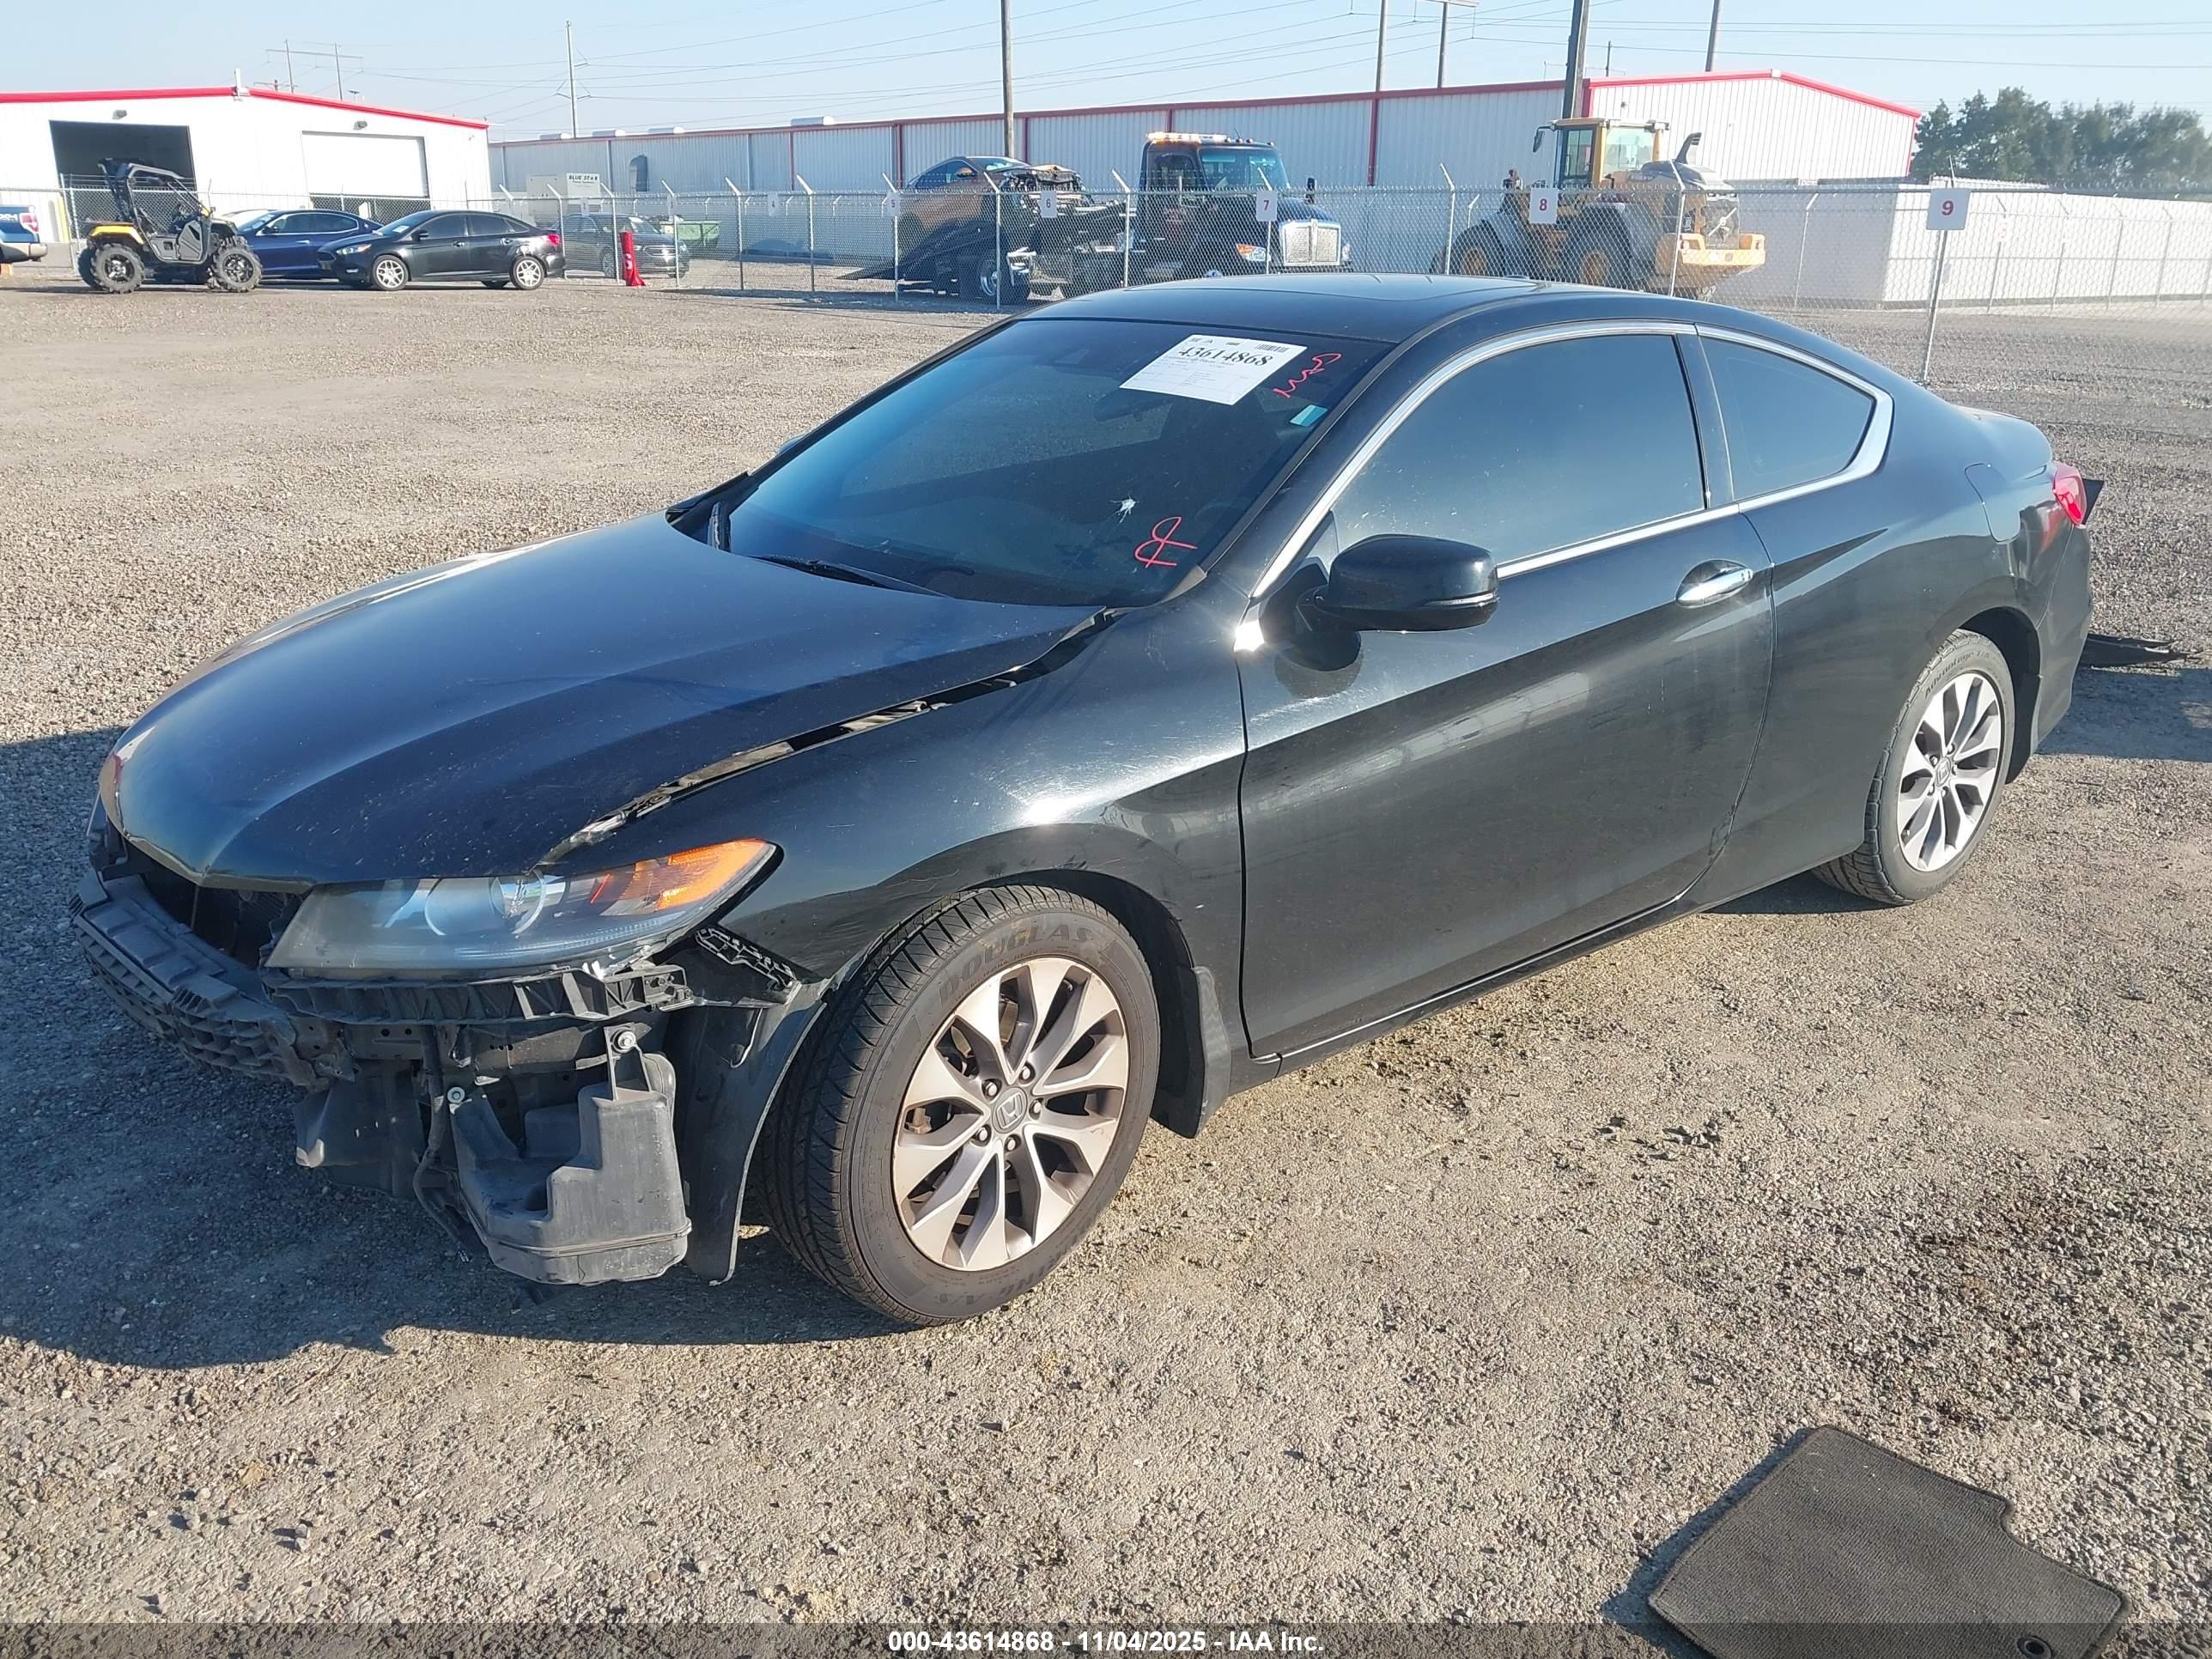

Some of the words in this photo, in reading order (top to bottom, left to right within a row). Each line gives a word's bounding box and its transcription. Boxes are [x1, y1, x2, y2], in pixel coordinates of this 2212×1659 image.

[890, 199, 896, 208] 5
[1046, 198, 1051, 208] 6
[1263, 199, 1270, 211] 7
[1539, 198, 1547, 211] 8
[1941, 200, 1954, 216] 9
[1178, 346, 1273, 366] 43614868
[939, 924, 1093, 1006] DOUGLAS
